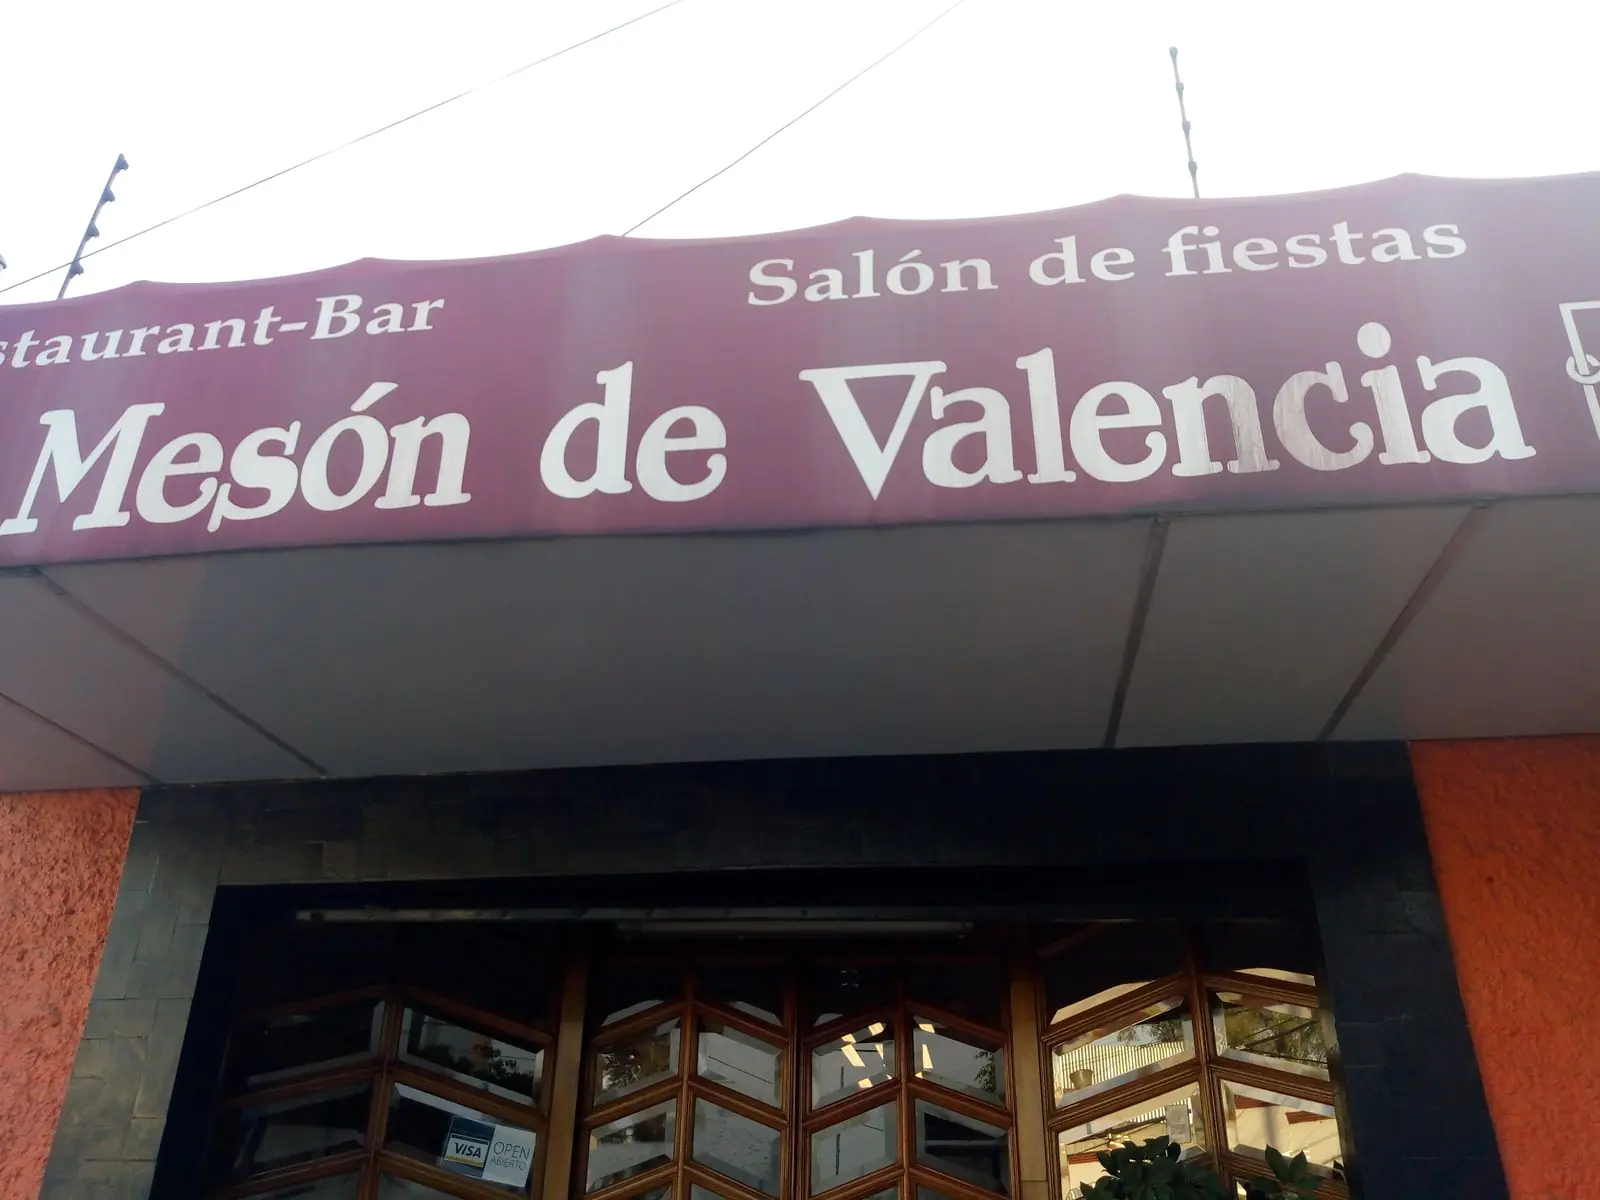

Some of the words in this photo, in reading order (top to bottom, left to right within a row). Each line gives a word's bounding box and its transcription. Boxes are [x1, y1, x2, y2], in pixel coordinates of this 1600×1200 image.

[748, 249, 999, 306] Salón
[1029, 235, 1135, 286] de
[1162, 221, 1468, 277] fiestas
[0, 381, 472, 536] Mesón
[540, 360, 728, 503] de
[798, 321, 1537, 501] Valencia
[455, 1142, 481, 1159] VISA
[493, 1141, 531, 1160] OPEN
[490, 1157, 527, 1171] ABIERTO
